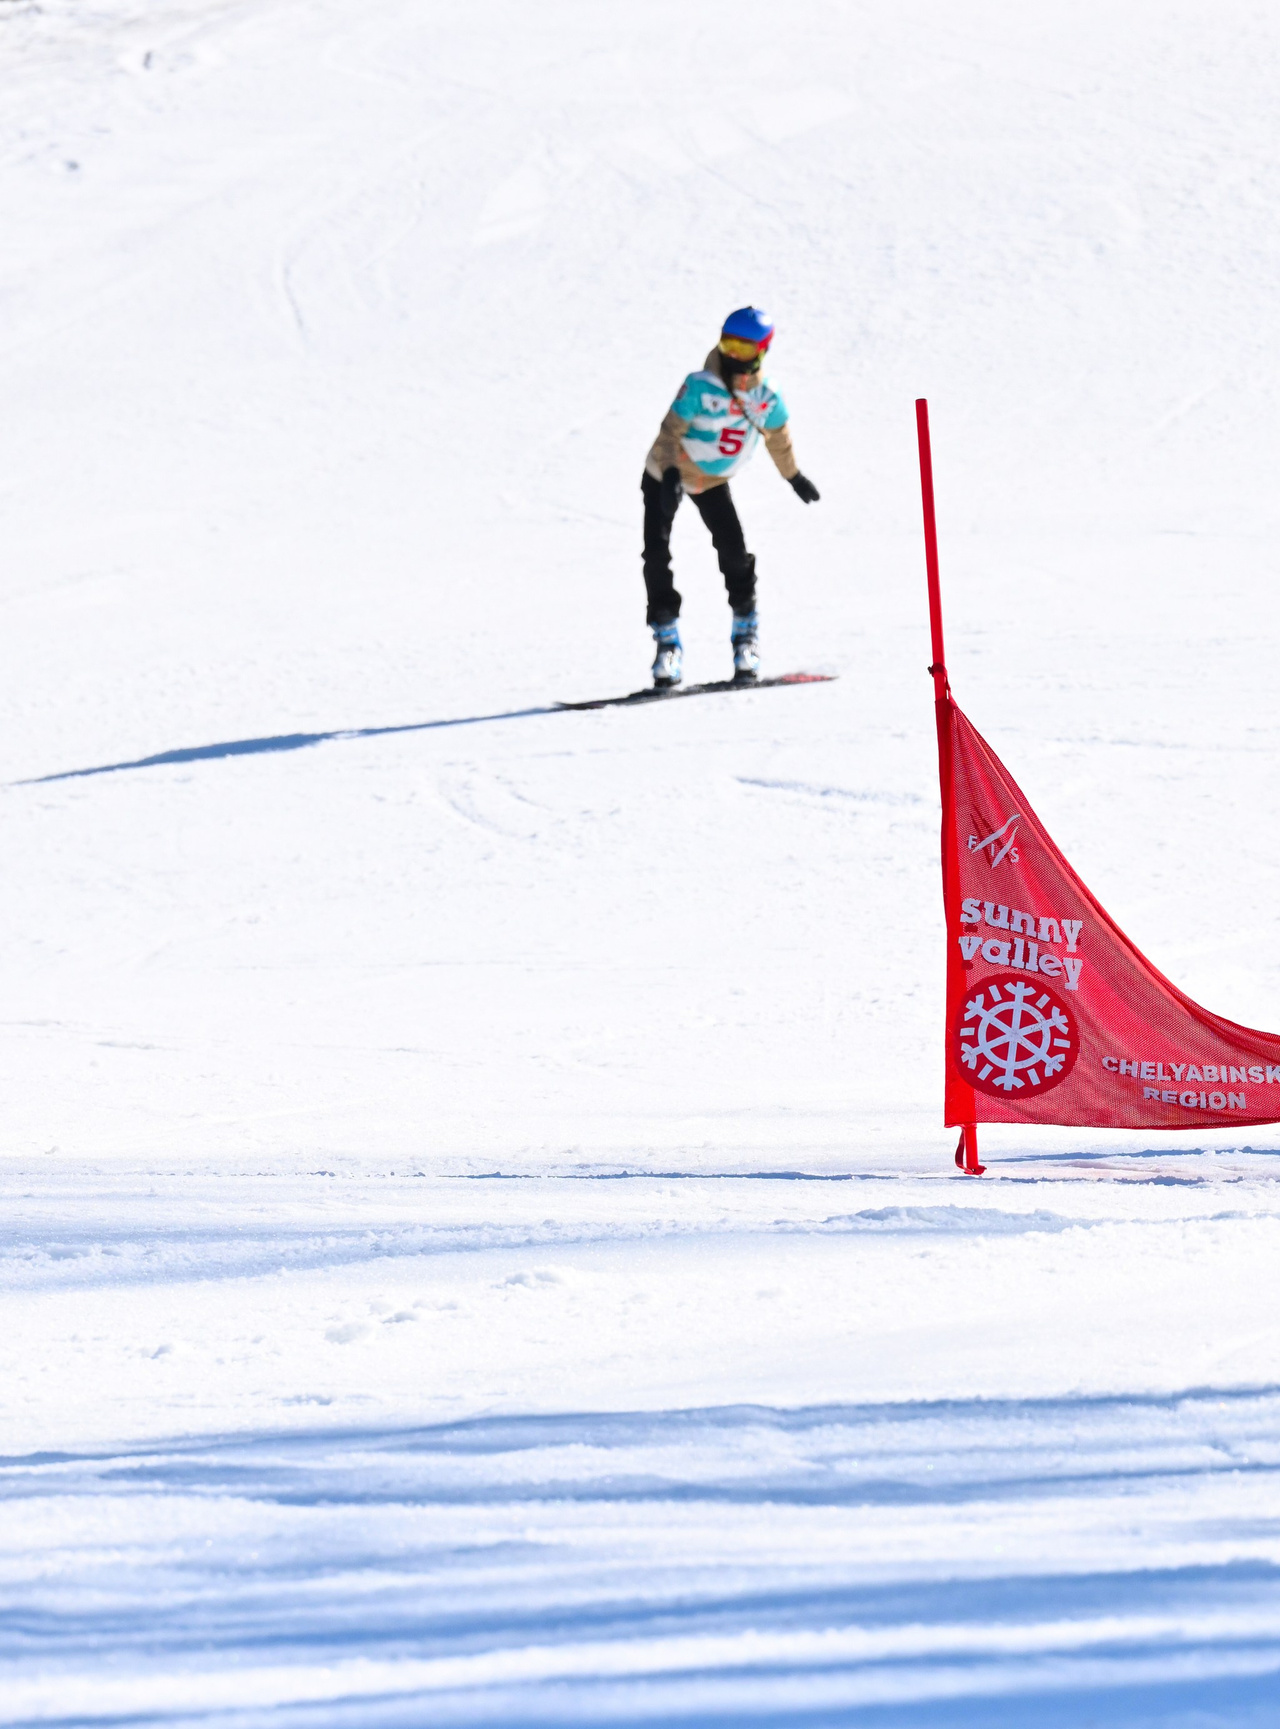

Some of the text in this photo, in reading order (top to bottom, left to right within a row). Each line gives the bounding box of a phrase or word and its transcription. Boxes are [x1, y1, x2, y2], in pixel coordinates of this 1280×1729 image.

[718, 428, 746, 456] 5
[960, 898, 1083, 952] sunny
[958, 936, 1083, 991] valley
[1143, 1087, 1247, 1110] REGION
